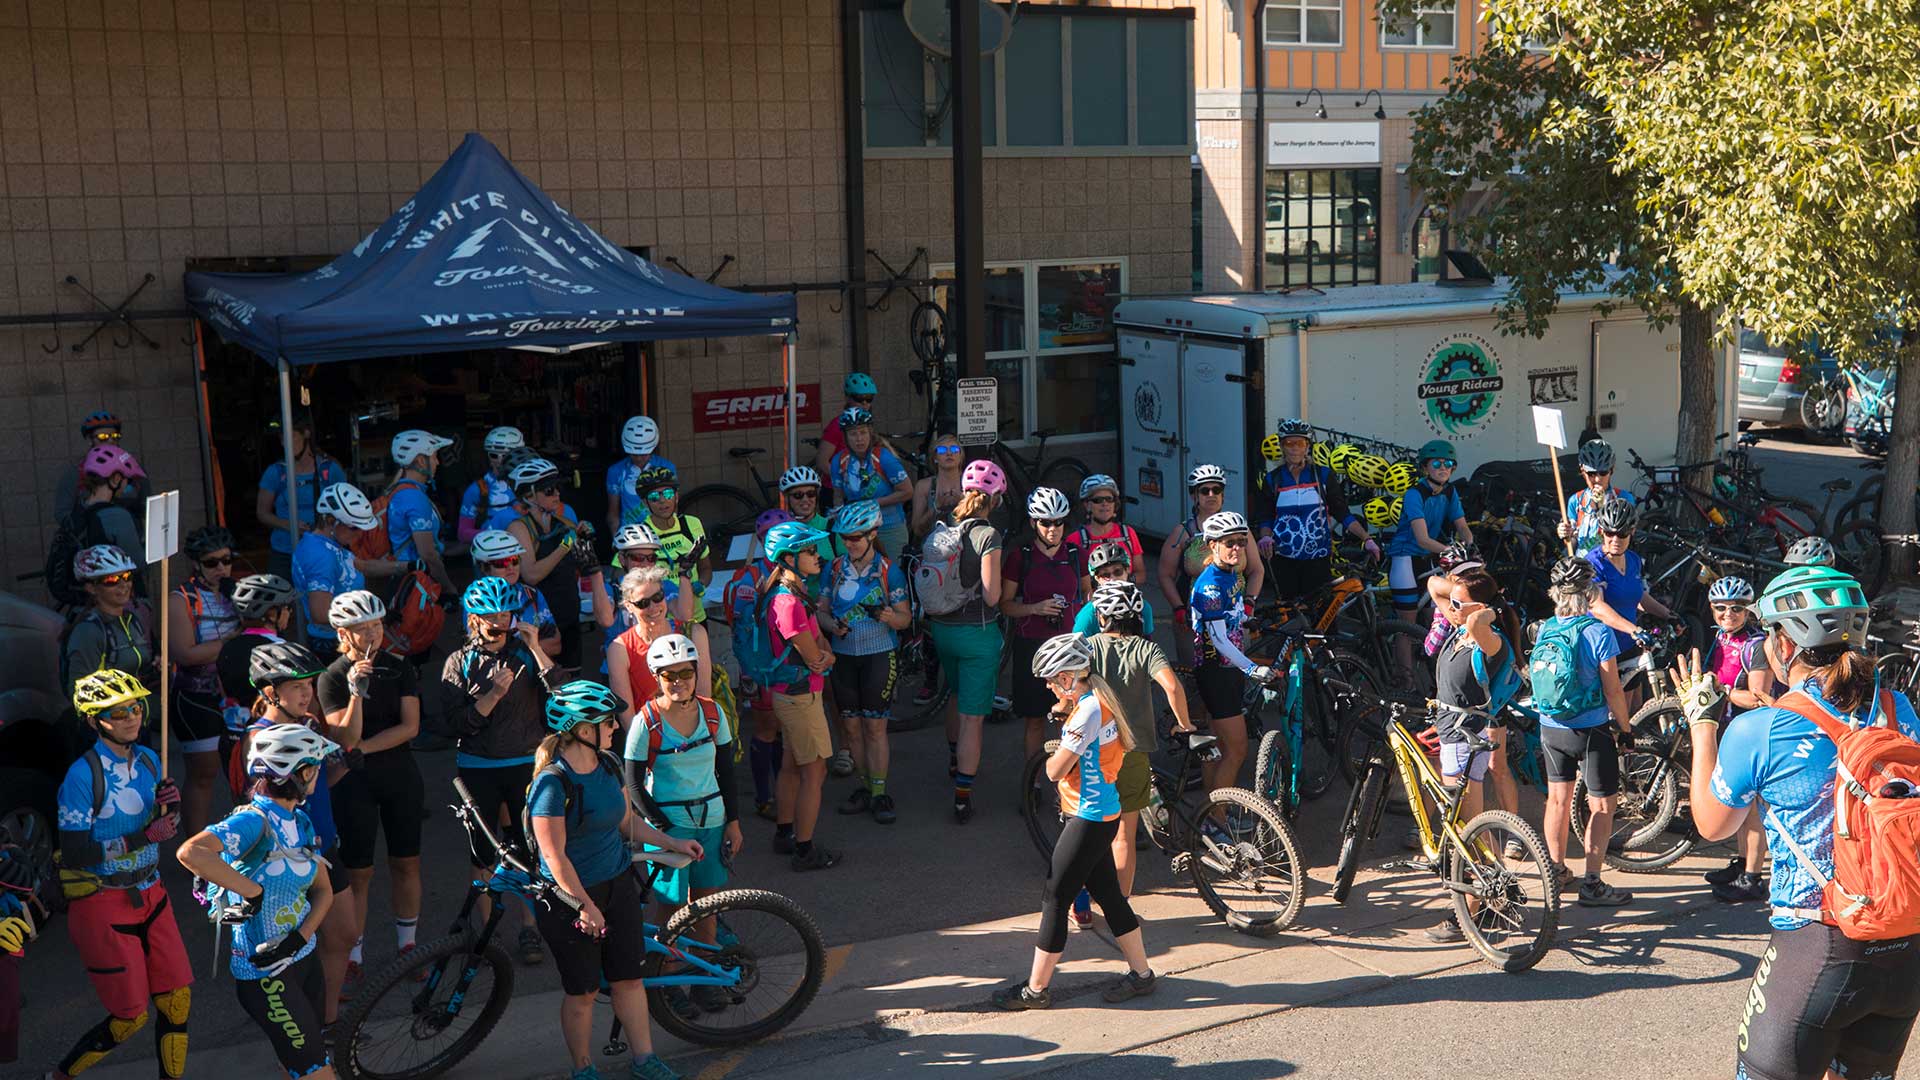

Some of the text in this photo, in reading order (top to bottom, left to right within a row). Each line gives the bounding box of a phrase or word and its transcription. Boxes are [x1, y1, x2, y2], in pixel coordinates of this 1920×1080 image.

[406, 191, 508, 250] WHITE
[520, 208, 600, 270] PINE
[433, 264, 601, 295] Touring
[504, 317, 621, 338] Touring
[1418, 337, 1449, 378] MOUNTAIN
[1476, 336, 1503, 371] PROGRAM
[962, 388, 993, 396] RESERVED
[1421, 379, 1500, 397] Young Riders
[1864, 941, 1910, 956] Touring
[260, 976, 306, 1050] Sugar
